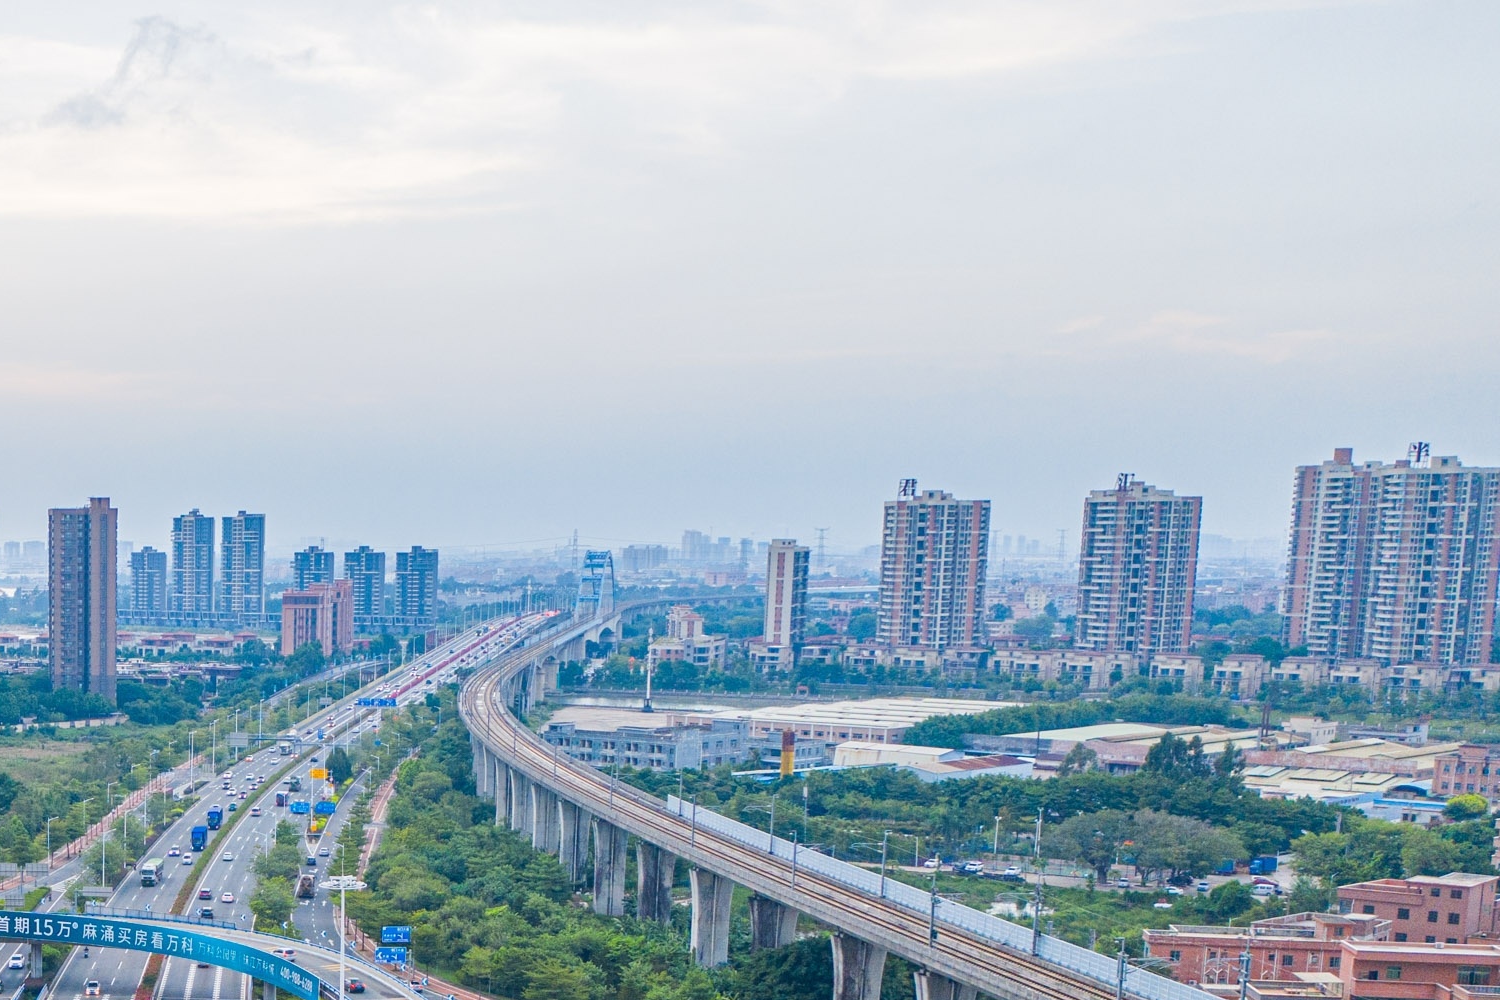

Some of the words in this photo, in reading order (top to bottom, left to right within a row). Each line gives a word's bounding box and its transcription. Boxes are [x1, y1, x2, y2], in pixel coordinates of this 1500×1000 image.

[82, 922, 194, 955] 麻涌买房看万科
